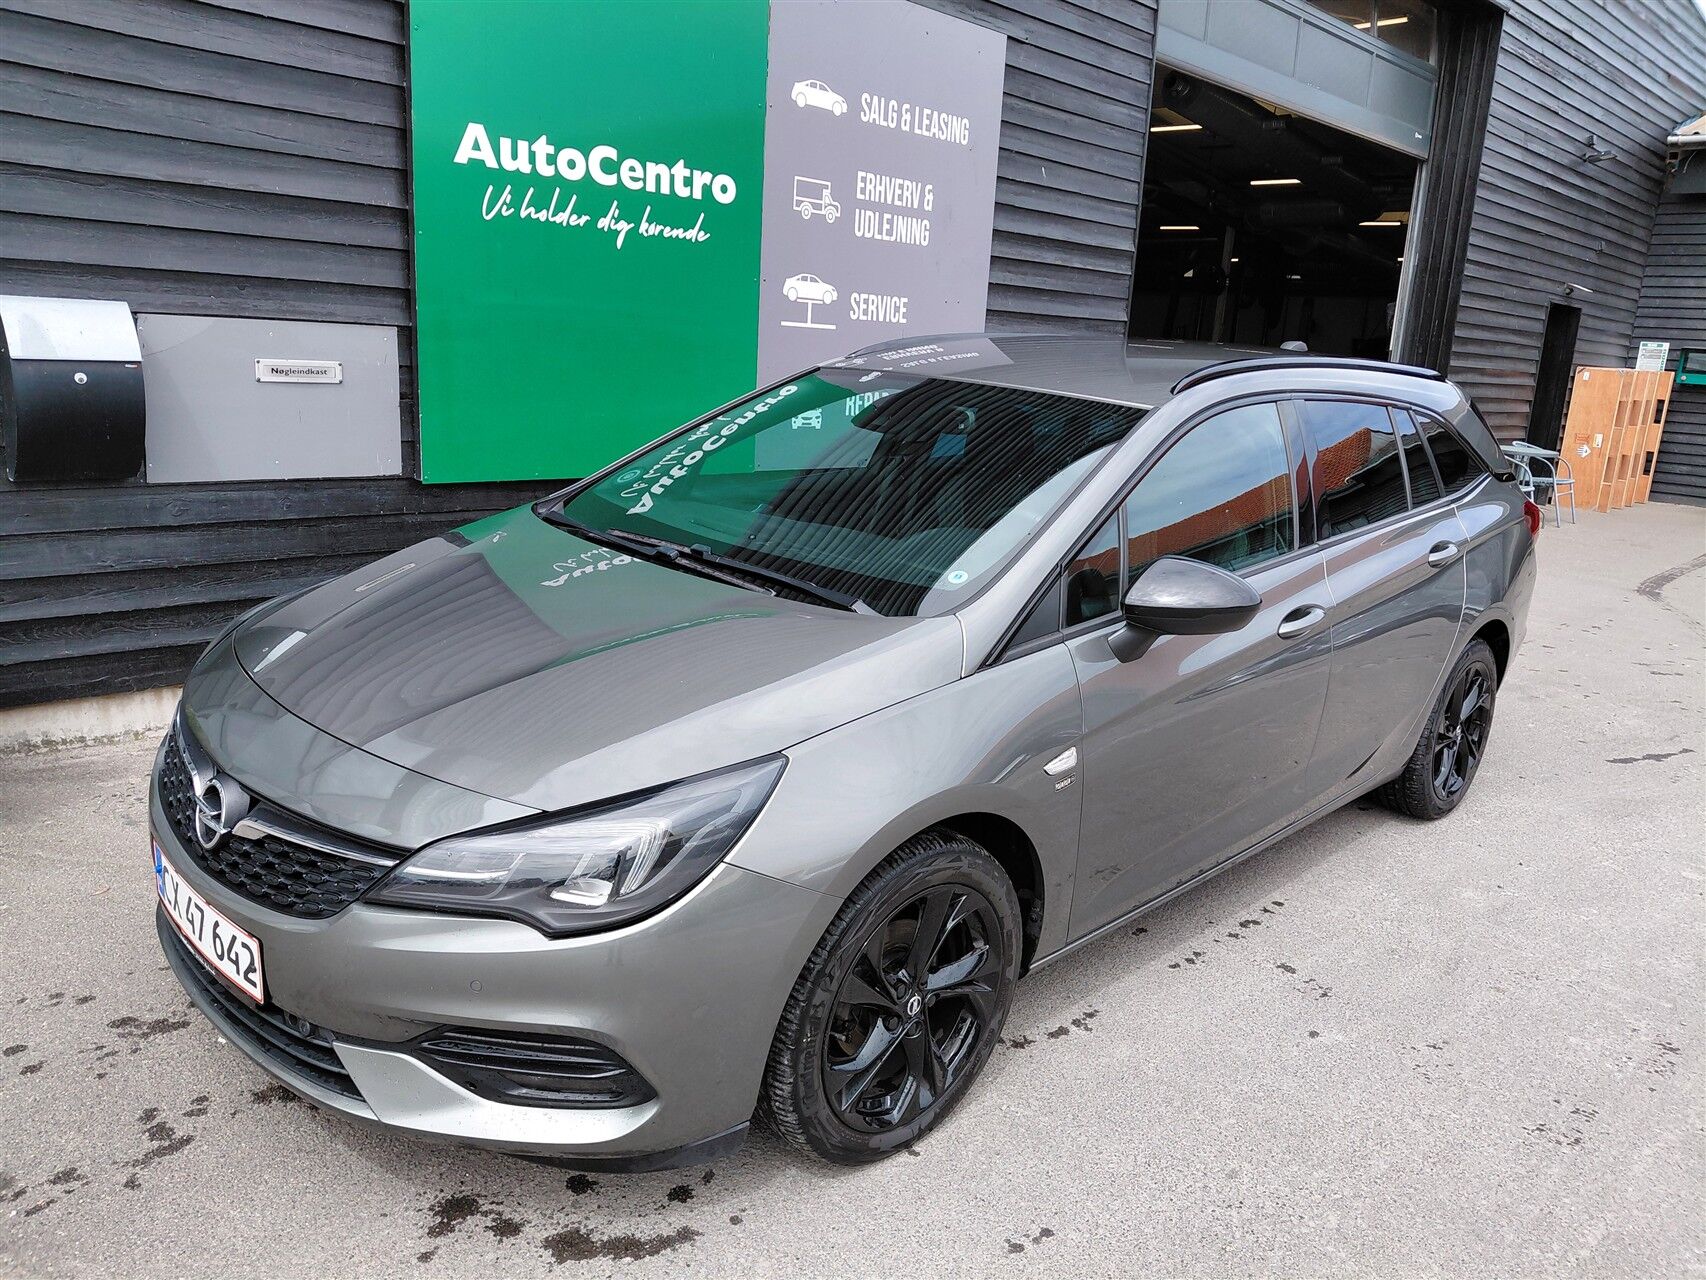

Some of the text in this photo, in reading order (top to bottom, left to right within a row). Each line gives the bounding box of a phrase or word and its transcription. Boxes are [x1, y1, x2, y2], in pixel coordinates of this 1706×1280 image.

[860, 92, 970, 146] SALG & LEASING
[453, 122, 737, 205] AutoCentro
[856, 170, 934, 212] ERHVERV &
[481, 184, 513, 220] Vi
[519, 186, 591, 227] holder
[597, 200, 635, 249] dig
[854, 209, 930, 247] UDLEJNING
[849, 292, 908, 324] SERVICE
[271, 367, 328, 376] Nøgleindkast
[163, 866, 182, 920] CX
[186, 896, 205, 943] 47
[213, 920, 257, 989] 642
